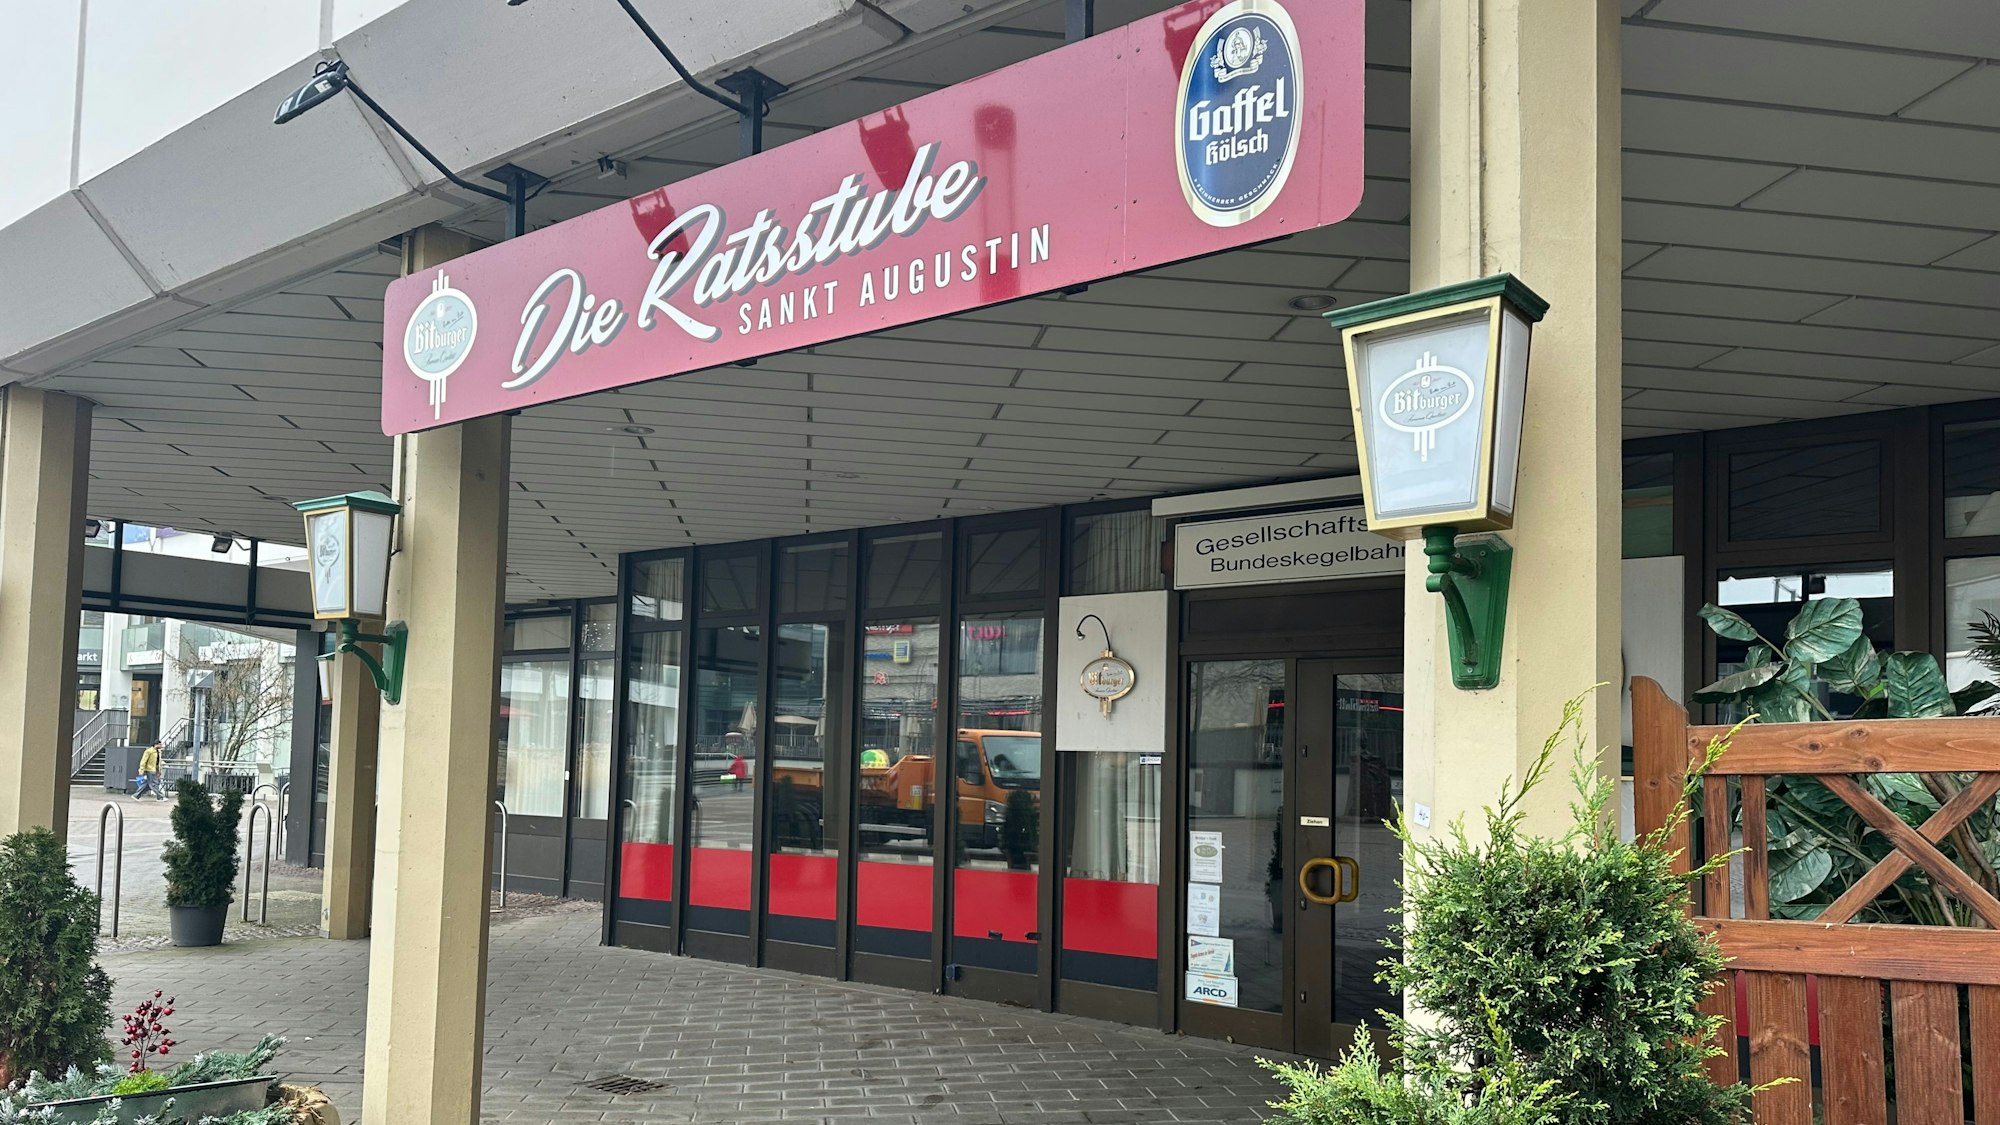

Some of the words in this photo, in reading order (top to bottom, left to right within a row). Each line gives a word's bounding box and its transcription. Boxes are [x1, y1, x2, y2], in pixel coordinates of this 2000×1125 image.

[1189, 76, 1290, 141] Gaffel
[1205, 128, 1269, 166] Kölsch
[501, 268, 628, 390] Die
[637, 141, 987, 342] Ratsstube
[738, 280, 839, 335] SANKT
[858, 223, 1050, 307] AUGUSTIN
[413, 320, 467, 355] Bitburger
[1392, 388, 1461, 414] Bitburger
[1210, 543, 1405, 572] Bundeskegelbah
[1193, 986, 1227, 998] ARCD
